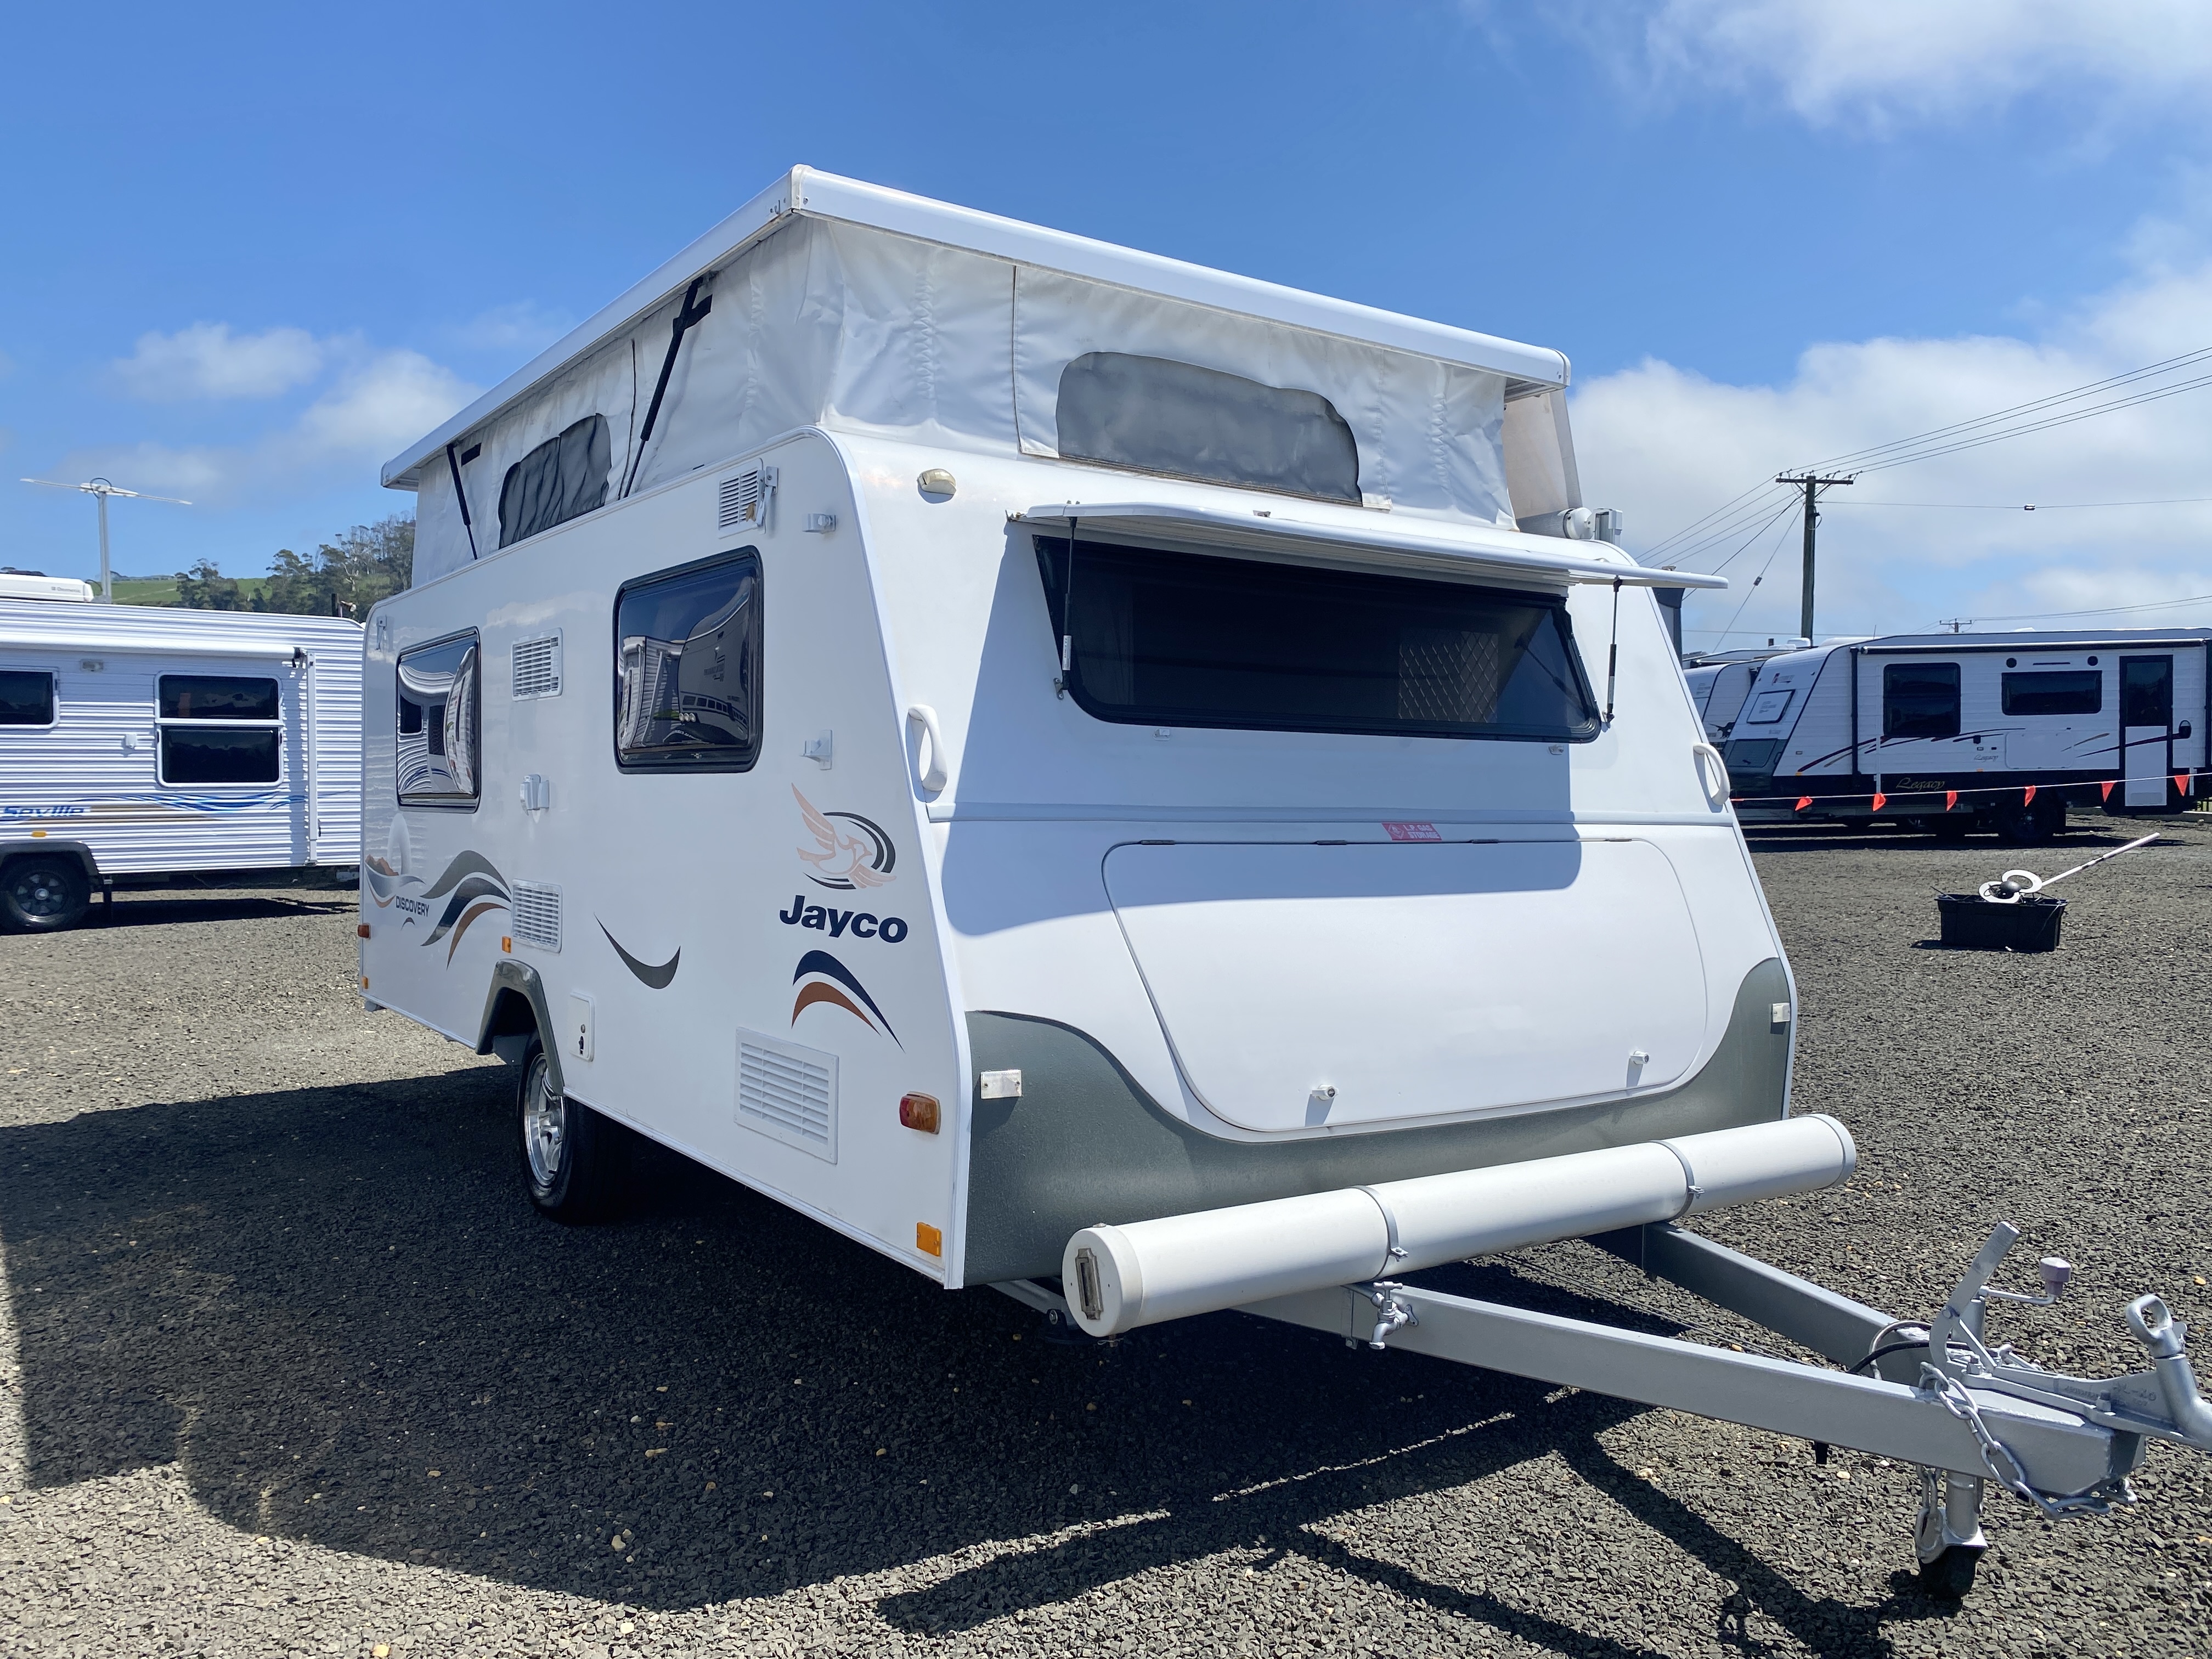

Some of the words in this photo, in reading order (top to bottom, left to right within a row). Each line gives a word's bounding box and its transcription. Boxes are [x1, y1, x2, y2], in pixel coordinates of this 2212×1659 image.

[1896, 777, 1945, 792] Legacy
[4, 805, 84, 817] Seville
[396, 895, 430, 917] DISCOVERY
[779, 894, 909, 944] Jayco
